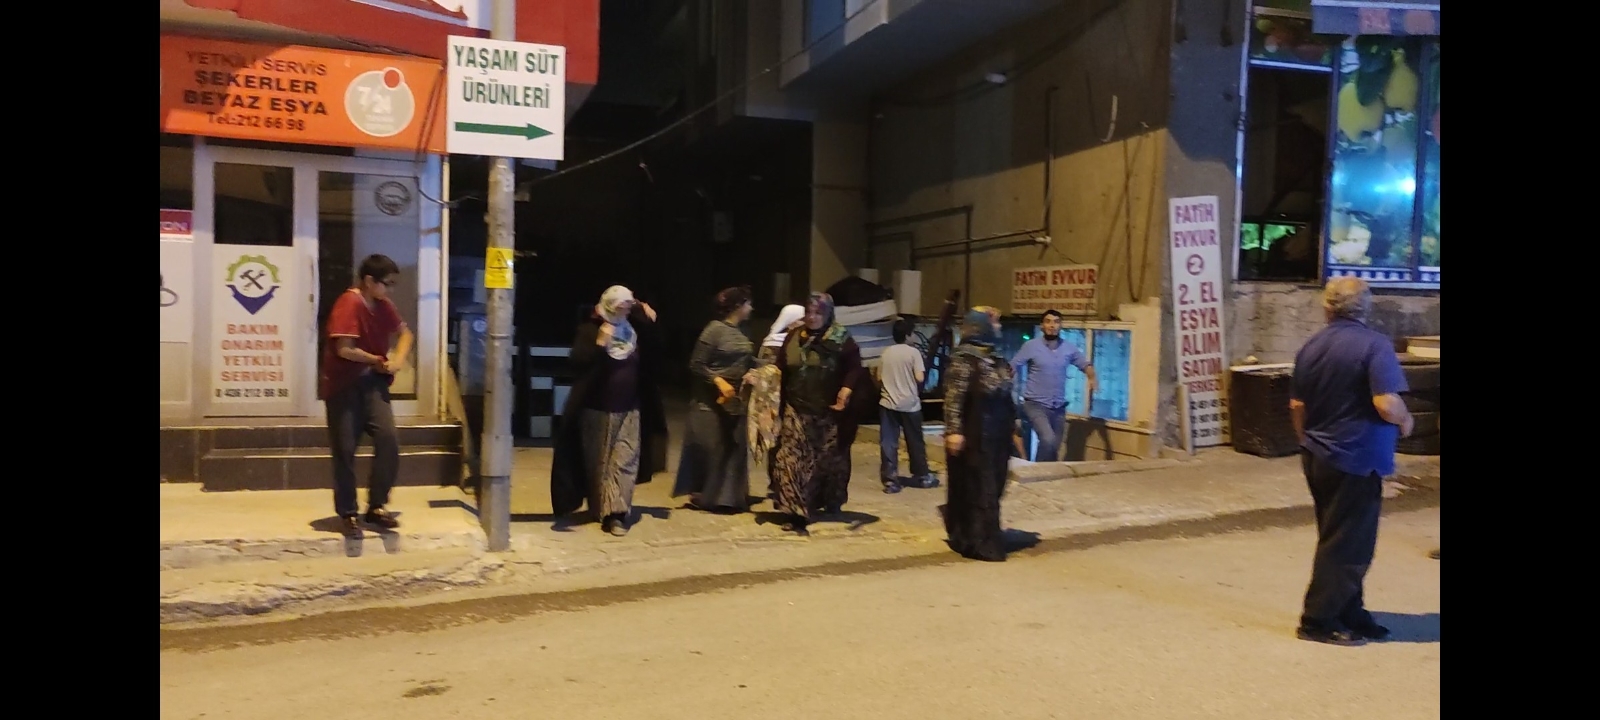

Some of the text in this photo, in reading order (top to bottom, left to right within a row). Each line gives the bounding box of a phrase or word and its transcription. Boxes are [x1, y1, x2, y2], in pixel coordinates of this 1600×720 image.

[261, 57, 327, 76] SERVİS
[453, 45, 559, 75] YAŞAM SÜT
[195, 69, 318, 94] ŞEKERLER
[462, 76, 550, 109] ÜRÜNLERİ
[183, 89, 328, 116] BEYAZ EŞYA
[264, 116, 284, 129] 66
[285, 118, 305, 131] 98
[160, 221, 189, 231] ON
[1173, 229, 1218, 248] EVKUR
[1051, 268, 1097, 286] EVKUR
[1178, 281, 1219, 305] 2. EL
[227, 323, 279, 335] BAKIM
[221, 339, 284, 351] ONARIM
[1182, 331, 1221, 356] ALIM
[223, 353, 282, 367] YETKİLİ
[1182, 357, 1223, 378] SATIM
[221, 369, 284, 382] SERVİSİ
